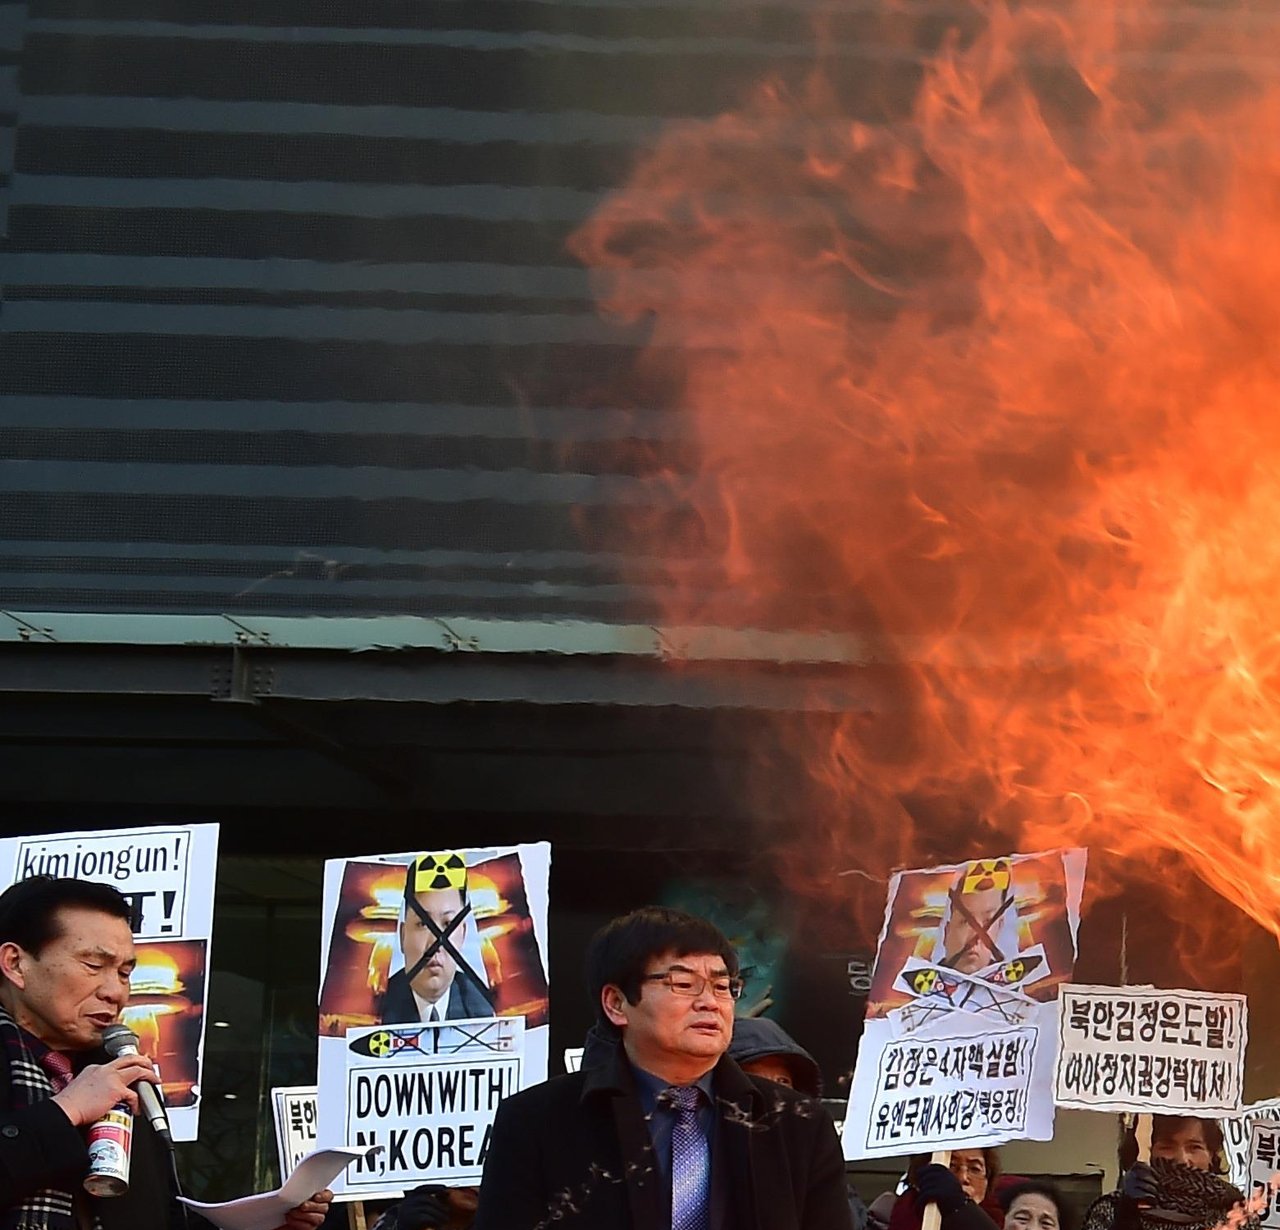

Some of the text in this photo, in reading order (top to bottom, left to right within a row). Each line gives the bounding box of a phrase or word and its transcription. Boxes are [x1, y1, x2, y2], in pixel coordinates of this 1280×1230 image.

[1070, 999, 1236, 1049] 북한김정은도발!
[1065, 1052, 1233, 1103] 여야정치권강력대처!
[875, 1088, 1025, 1142] 유엔국제사회강력응징!
